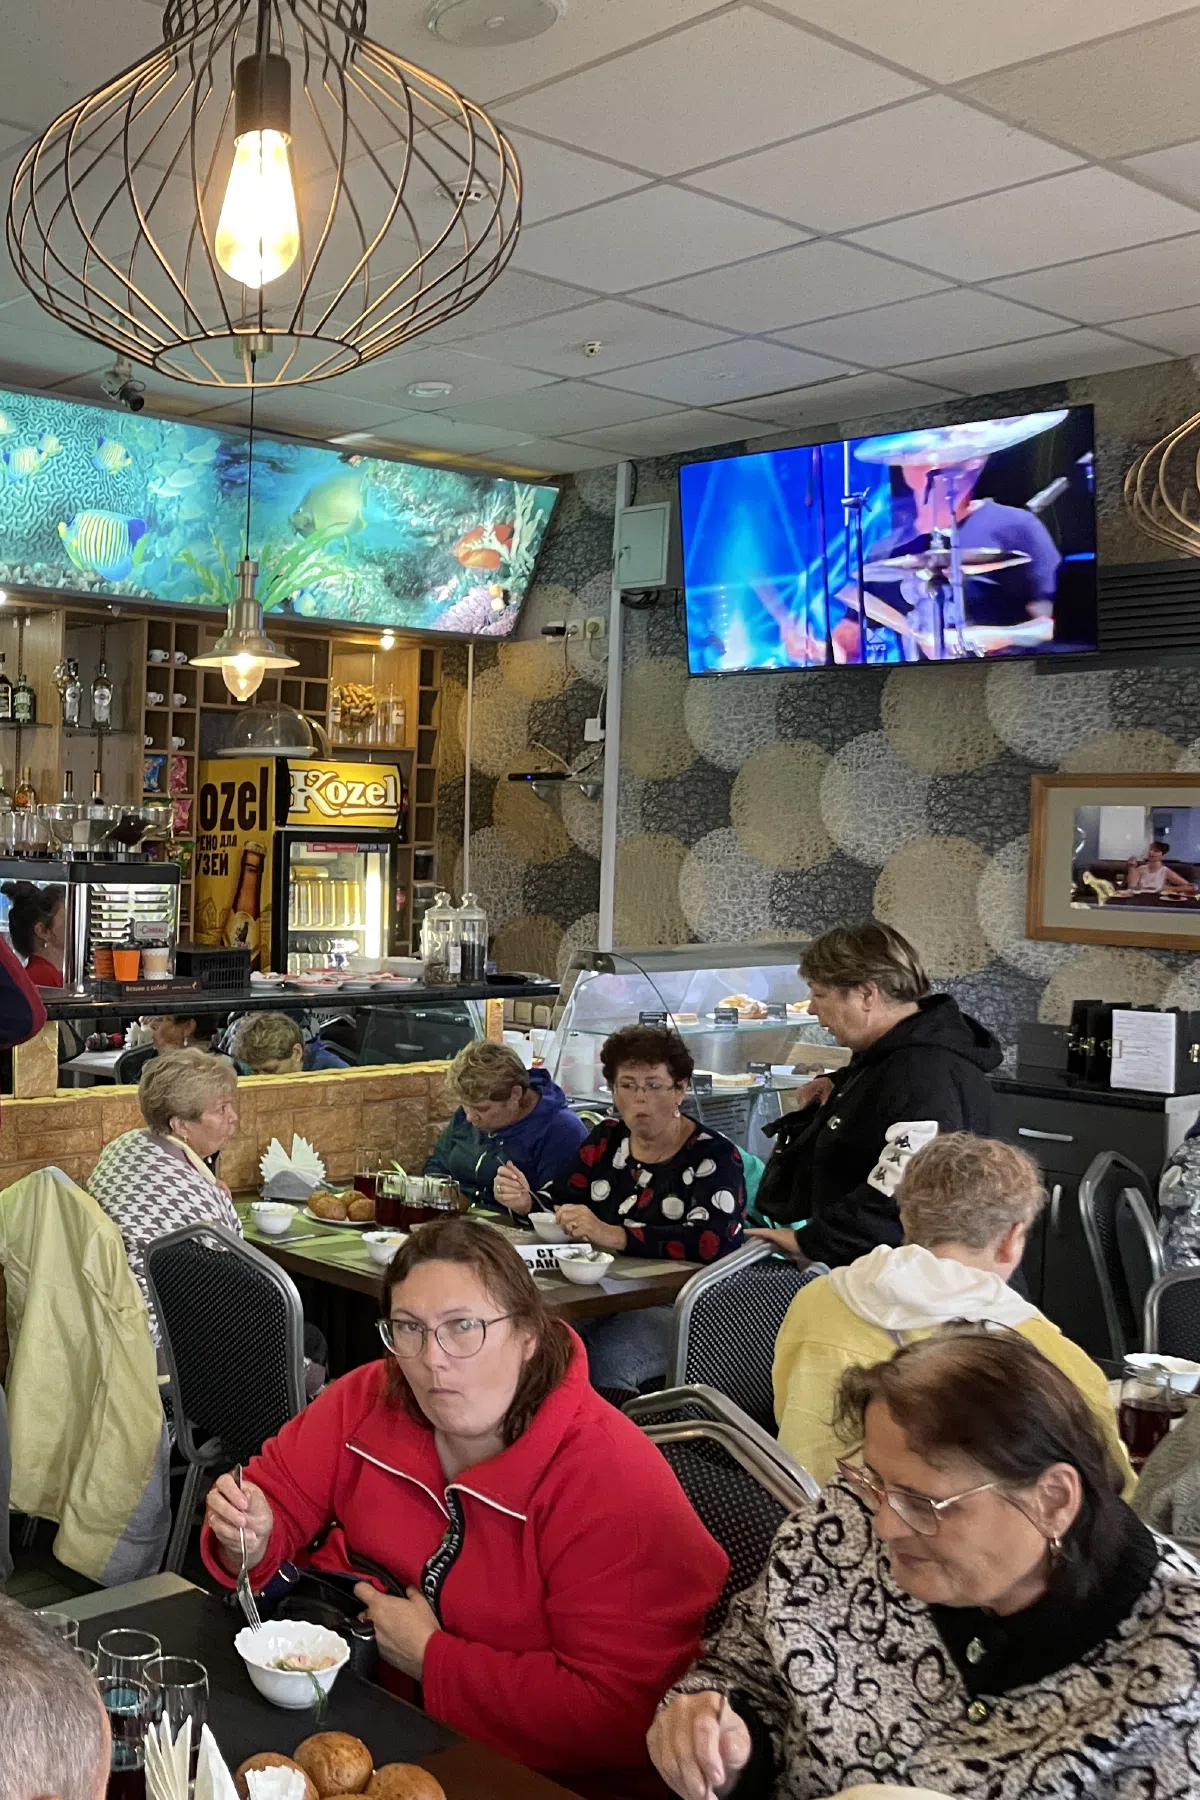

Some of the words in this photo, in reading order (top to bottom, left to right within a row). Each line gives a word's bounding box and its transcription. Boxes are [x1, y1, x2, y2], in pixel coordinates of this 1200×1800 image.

[199, 766, 269, 831] ozel
[289, 769, 398, 816] Kozel
[220, 835, 237, 848] ДЛЯ
[195, 849, 228, 876] УЗЕЙ
[537, 1248, 558, 1258] СТ
